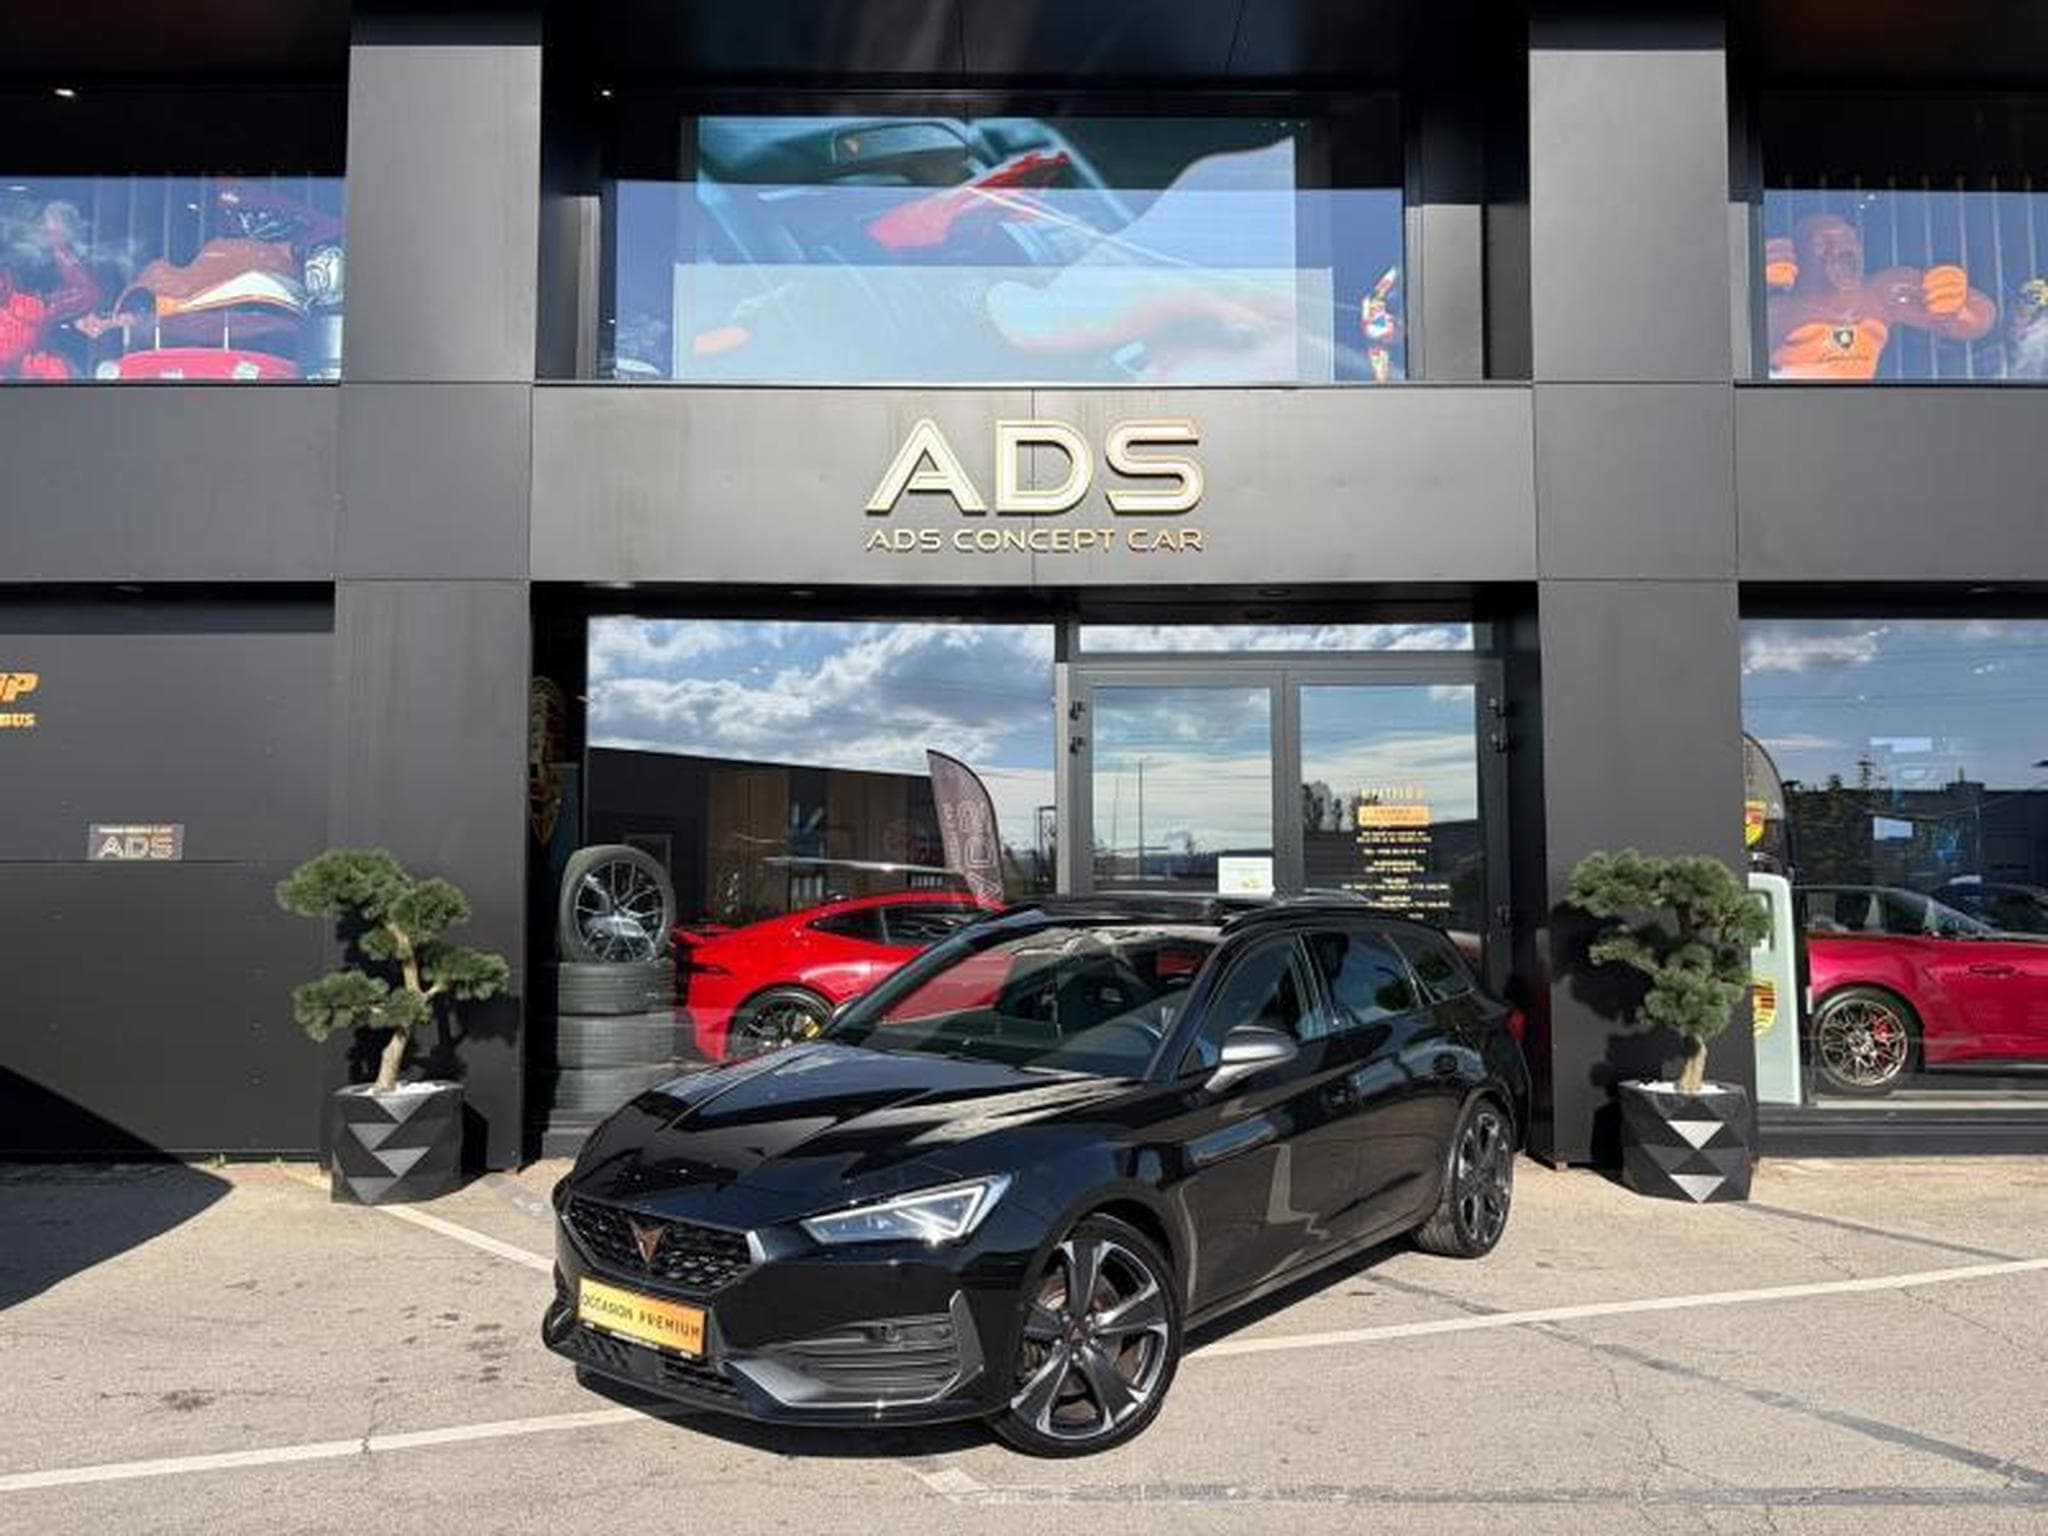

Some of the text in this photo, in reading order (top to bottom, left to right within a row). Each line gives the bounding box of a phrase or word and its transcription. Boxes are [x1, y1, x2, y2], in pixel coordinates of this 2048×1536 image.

[865, 417, 1204, 516] ADS
[866, 529, 1205, 552] ADS CONCEPT CAR
[98, 835, 174, 860] ADS
[583, 1293, 700, 1337] OCCASION PREMIUM
